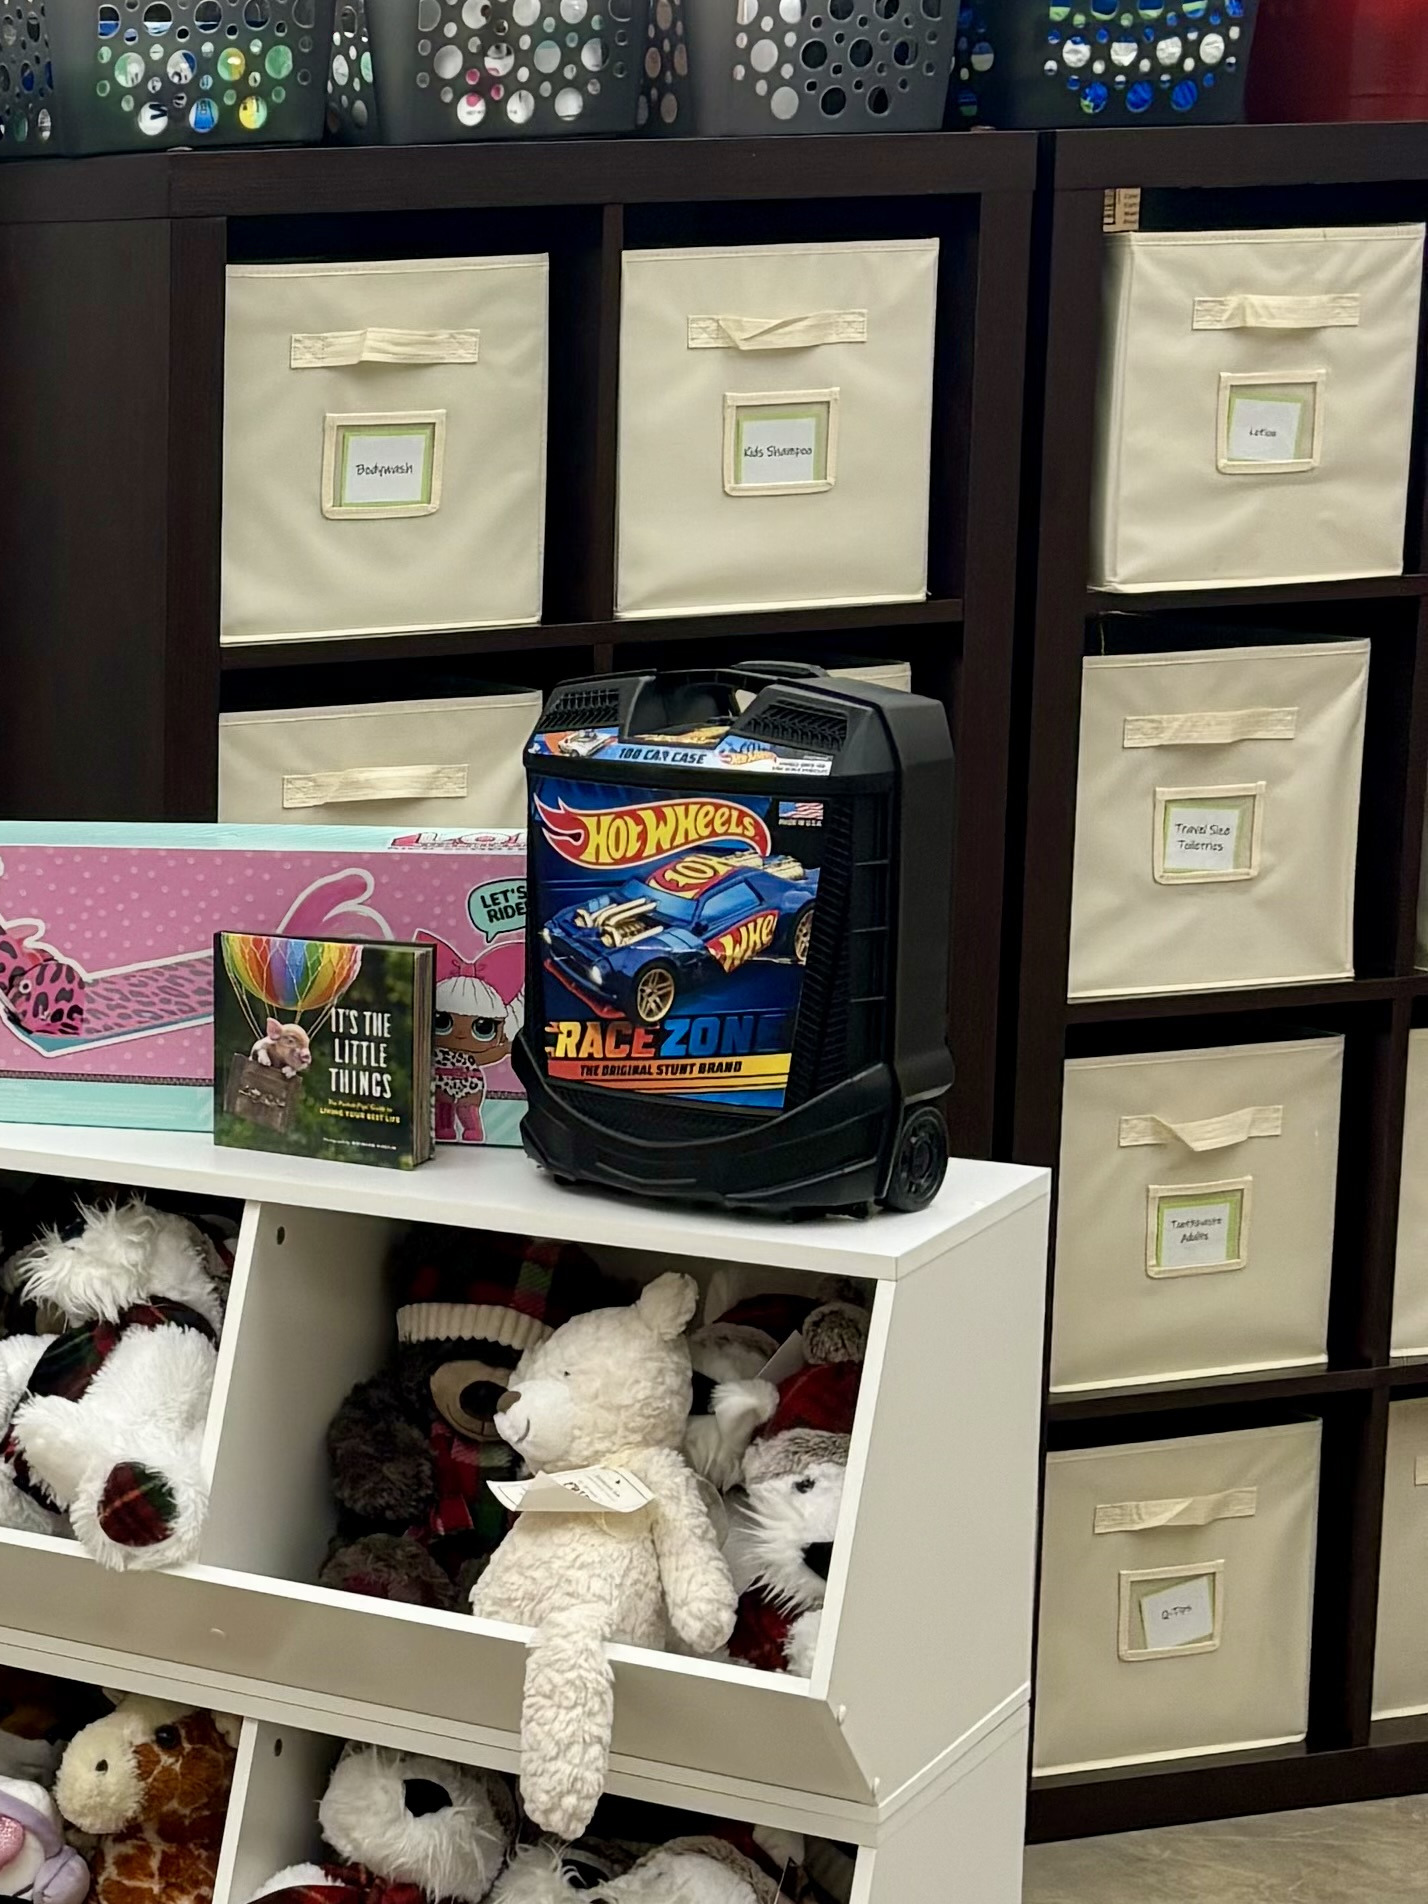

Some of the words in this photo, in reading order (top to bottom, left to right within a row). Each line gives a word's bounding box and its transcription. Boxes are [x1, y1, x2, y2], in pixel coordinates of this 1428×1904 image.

[744, 443, 764, 459] Kids
[765, 444, 814, 460] Shampoo
[355, 461, 416, 480] Bodywash
[618, 748, 640, 761] 100
[643, 750, 670, 763] CAR
[672, 752, 705, 766] CASE
[1174, 820, 1207, 838] Travel
[1208, 820, 1231, 837] Size
[1176, 837, 1224, 854] Toiletries
[331, 1006, 359, 1036] IT'S
[363, 1008, 392, 1039] THE
[555, 1020, 659, 1058] RACE
[334, 1038, 388, 1069] LITTLE
[580, 1063, 600, 1077] THE
[601, 1063, 653, 1077] ORIGINAL
[655, 1061, 696, 1076] STUNT
[698, 1060, 743, 1075] BRAND
[329, 1067, 393, 1099] THINGS
[319, 1107, 344, 1118] LIVING
[344, 1109, 365, 1120] YOUR
[366, 1111, 383, 1121] BEST
[384, 1114, 401, 1123] LIFE
